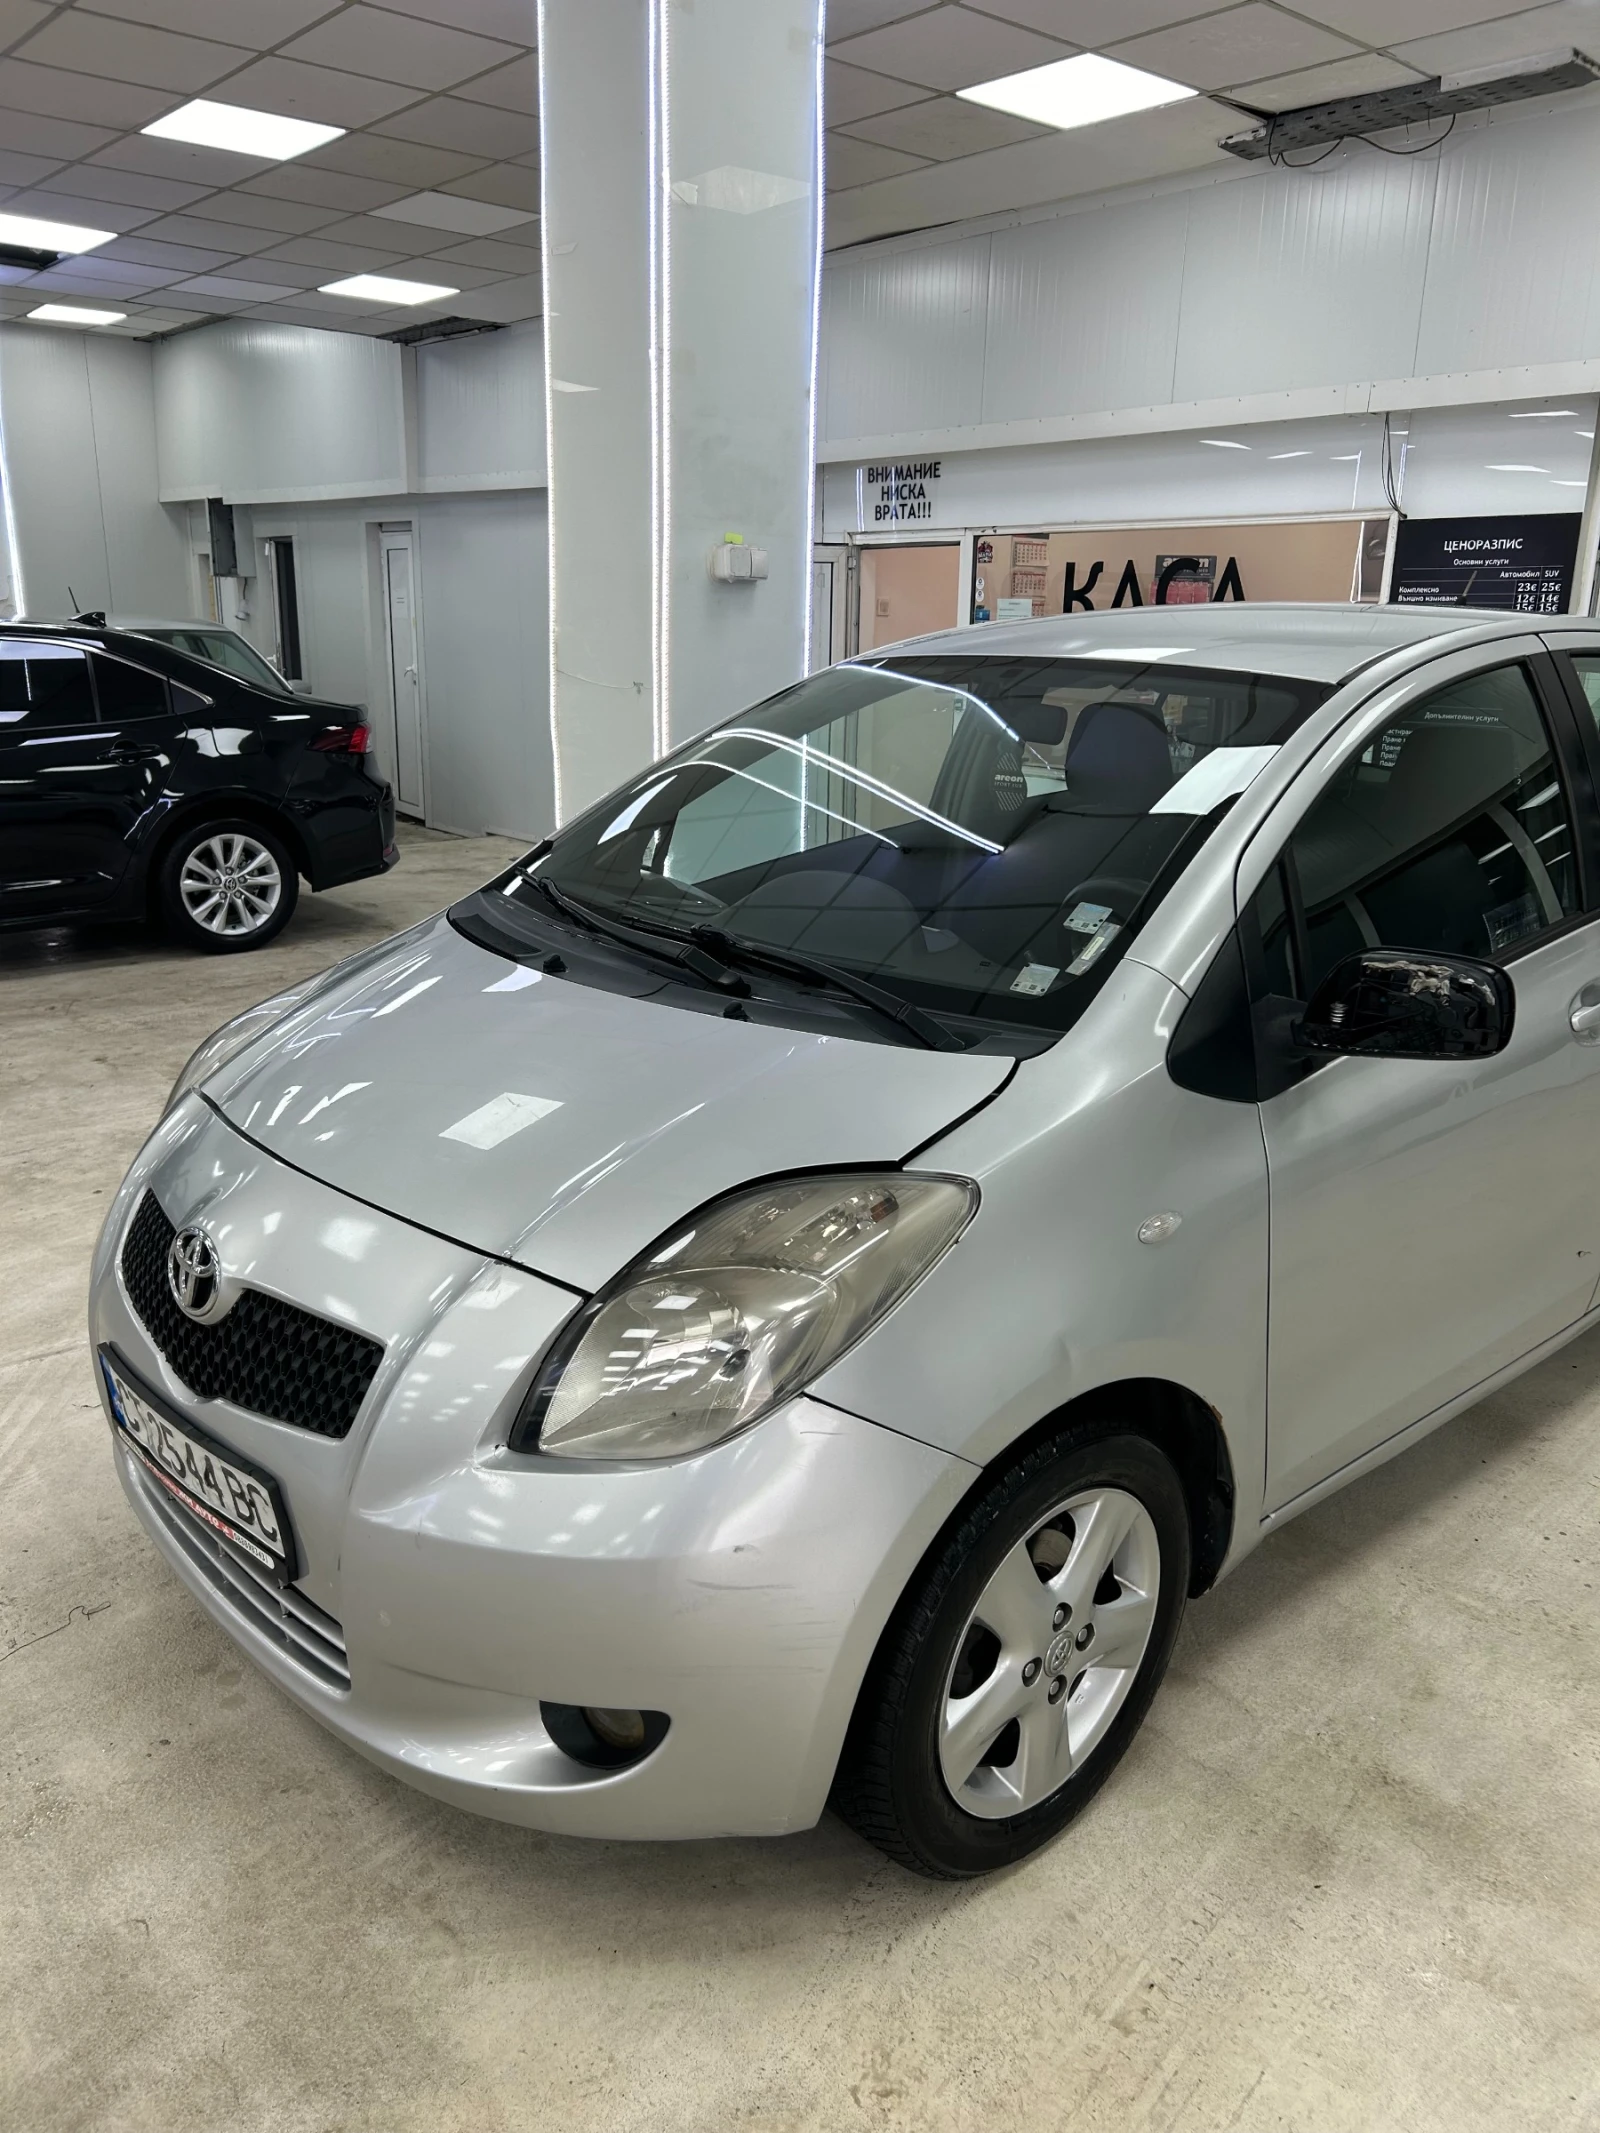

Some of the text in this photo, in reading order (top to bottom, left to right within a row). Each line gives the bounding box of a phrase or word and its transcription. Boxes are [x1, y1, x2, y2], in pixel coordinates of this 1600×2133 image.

[867, 462, 941, 483] ВНИМАНИЕ
[881, 483, 926, 501] НИСКА
[875, 502, 931, 521] ВРАТА!!!
[1443, 538, 1523, 553] ЦЕНОРАЗПИС
[1453, 558, 1509, 567] Основни услуги
[1517, 582, 1537, 592] 23€
[1541, 582, 1562, 592] 25€
[1516, 594, 1536, 603] 12€
[1540, 593, 1560, 603] 14€
[1424, 711, 1499, 723] Допълнителни услуги
[994, 774, 1023, 782] areon
